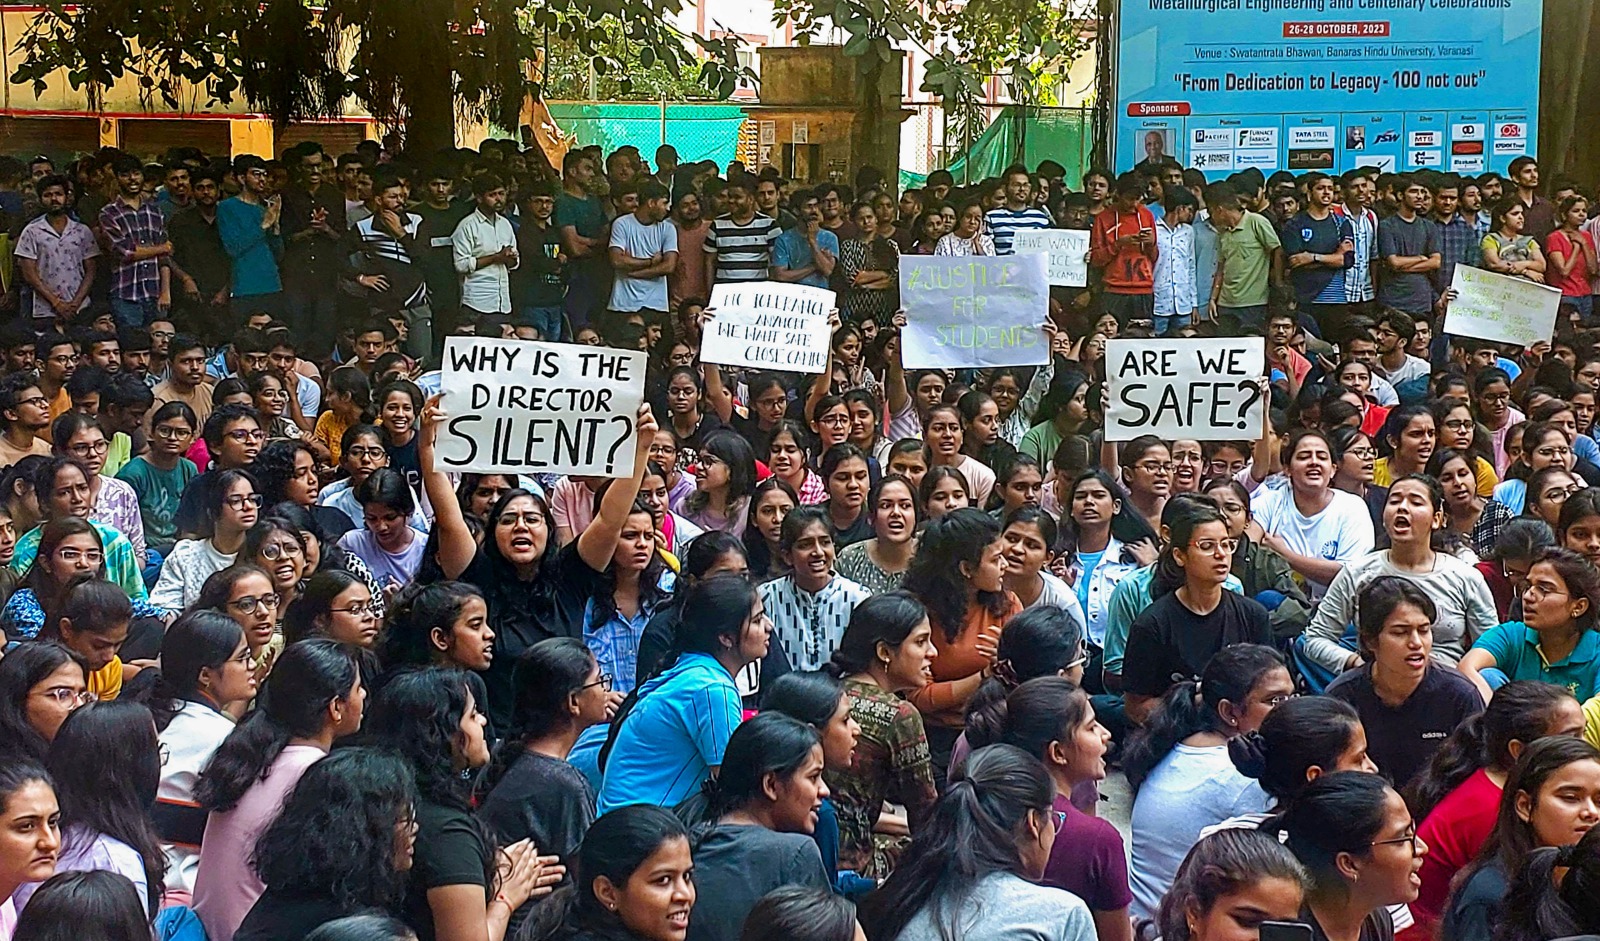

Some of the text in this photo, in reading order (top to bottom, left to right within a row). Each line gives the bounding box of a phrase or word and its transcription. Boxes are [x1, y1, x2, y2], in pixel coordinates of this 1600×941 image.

[1149, 0, 1511, 12] Metallurgical Engineering and Centenary Celebrations
[1289, 24, 1385, 35] 26-28 OCTOBER, 2023
[1194, 48, 1222, 59] Venue
[1229, 47, 1284, 59] Swatantrata
[1326, 46, 1362, 58] Banaras
[1364, 46, 1389, 57] Hindu
[1438, 45, 1474, 56] Varanasi
[1225, 72, 1304, 92] Dedication
[1309, 74, 1325, 89] to
[1392, 70, 1421, 89] 100
[1426, 73, 1450, 88] not
[1140, 103, 1178, 115] Sponsors
[1048, 237, 1086, 251] WANT
[934, 325, 1037, 349] STUDENTS
[450, 345, 632, 381] WHY IS THE
[1118, 349, 1247, 378] ARE WE
[471, 383, 613, 412] DIRECTOR
[1118, 380, 1261, 429] SAFE?
[443, 414, 633, 474] SILENT?
